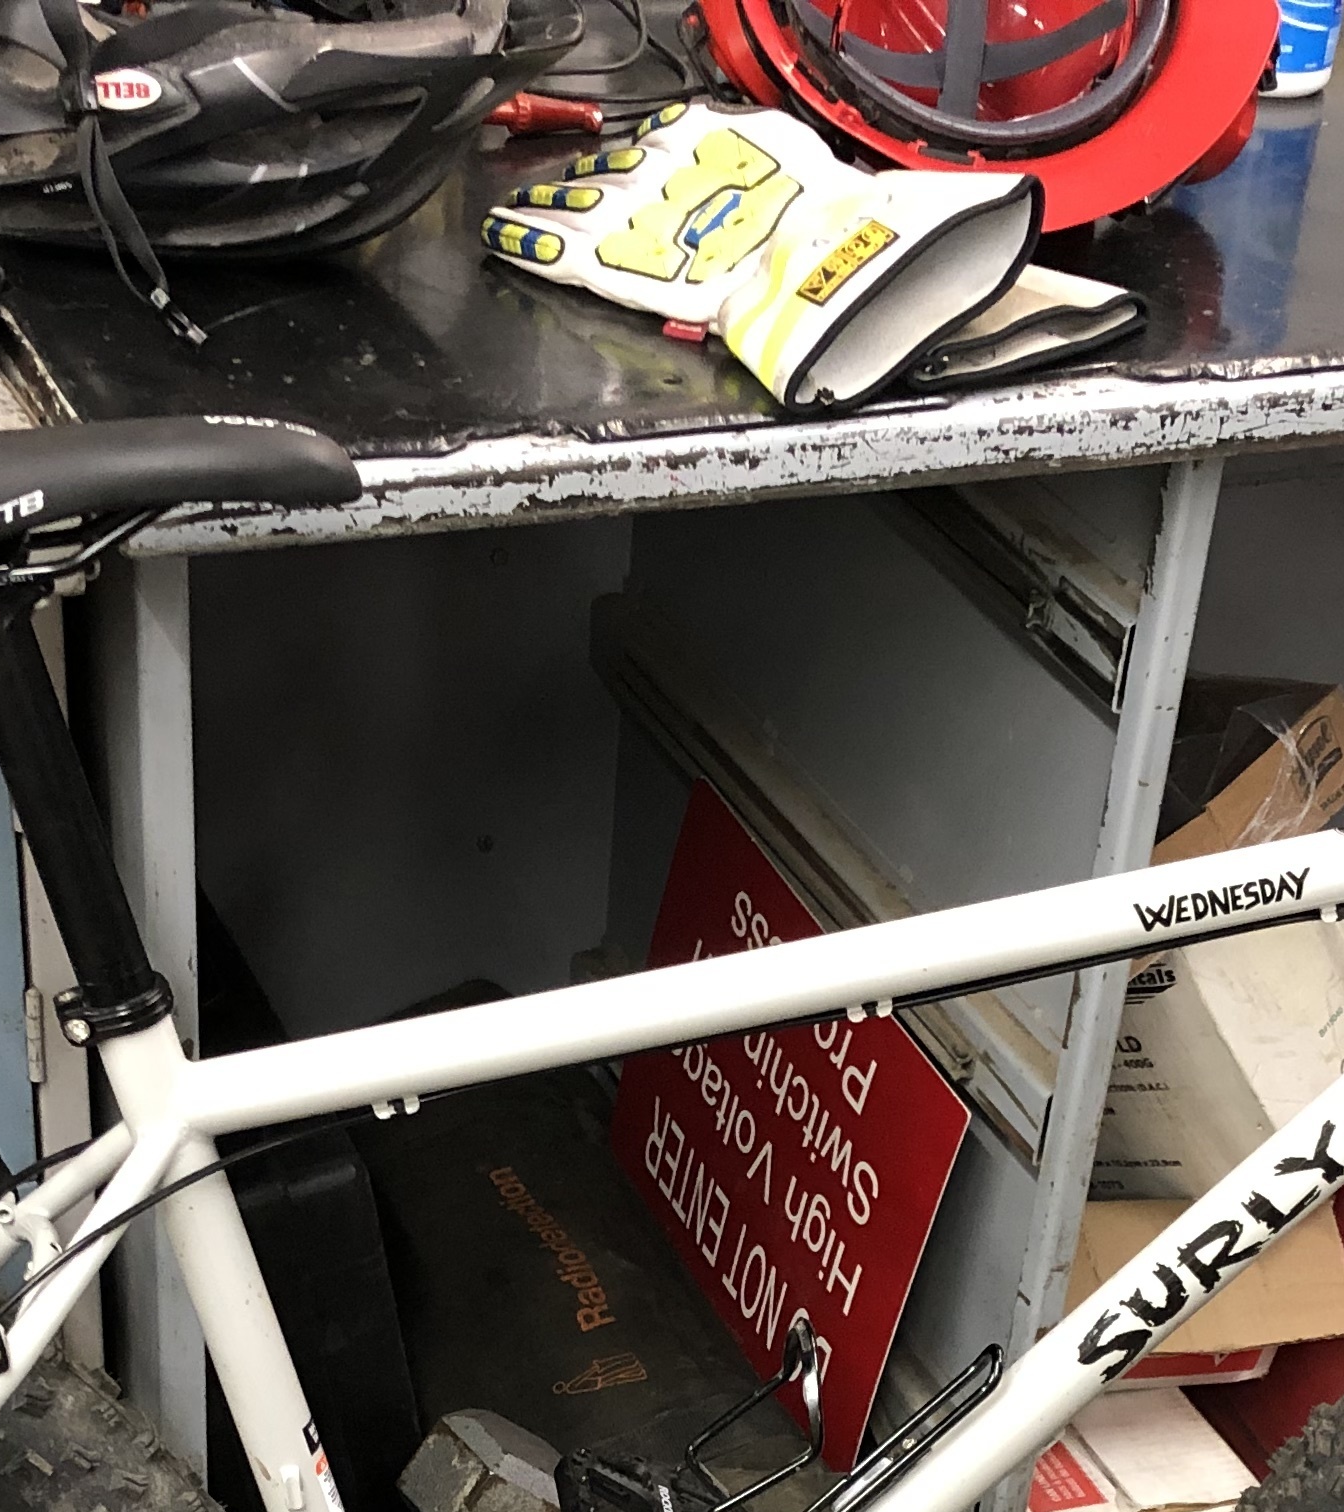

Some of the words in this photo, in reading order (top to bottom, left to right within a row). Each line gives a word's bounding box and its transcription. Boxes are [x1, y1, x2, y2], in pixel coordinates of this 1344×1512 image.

[97, 82, 150, 99] BELL
[1133, 867, 1310, 932] WEDNESDAY
[645, 1096, 730, 1267] ENTER
[671, 1041, 773, 1204] Voltag
[744, 1030, 878, 1224] Switchin
[722, 1223, 788, 1350] NOT
[784, 1176, 862, 1315] High
[1077, 1120, 1344, 1384] SURLY
